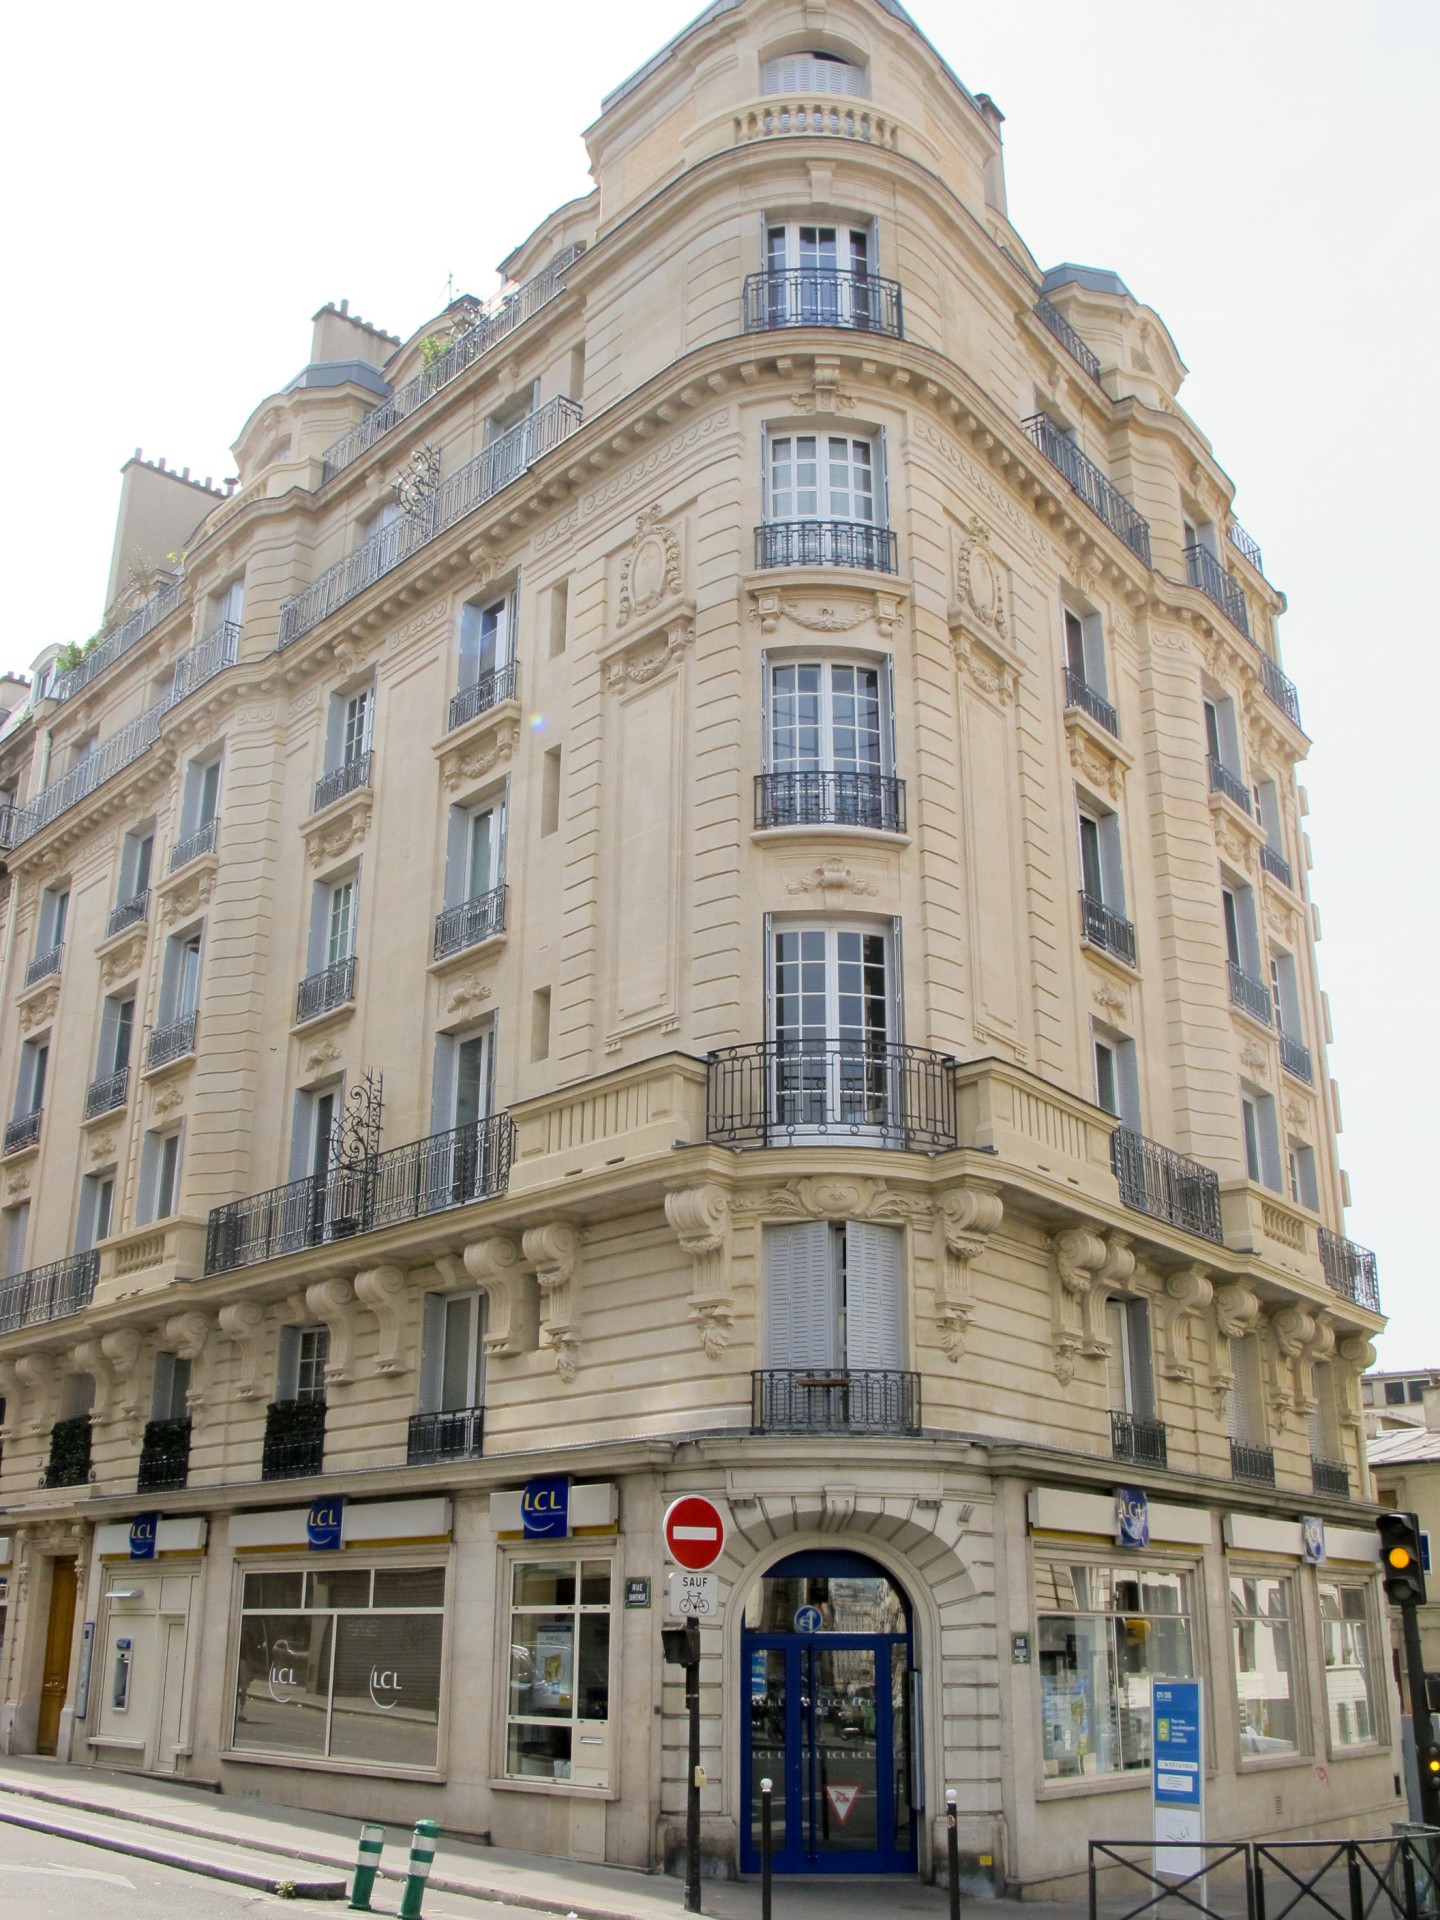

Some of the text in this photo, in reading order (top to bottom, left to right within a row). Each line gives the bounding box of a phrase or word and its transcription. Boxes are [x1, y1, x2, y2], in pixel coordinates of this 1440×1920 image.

[525, 1491, 562, 1511] LCL
[309, 1510, 338, 1526] LCL
[131, 1524, 153, 1538] LCL
[682, 1576, 708, 1587] SAUF
[271, 1668, 297, 1685] LCL
[373, 1671, 402, 1690] LCL
[827, 1751, 848, 1759] LCL
[852, 1751, 876, 1759] LCL
